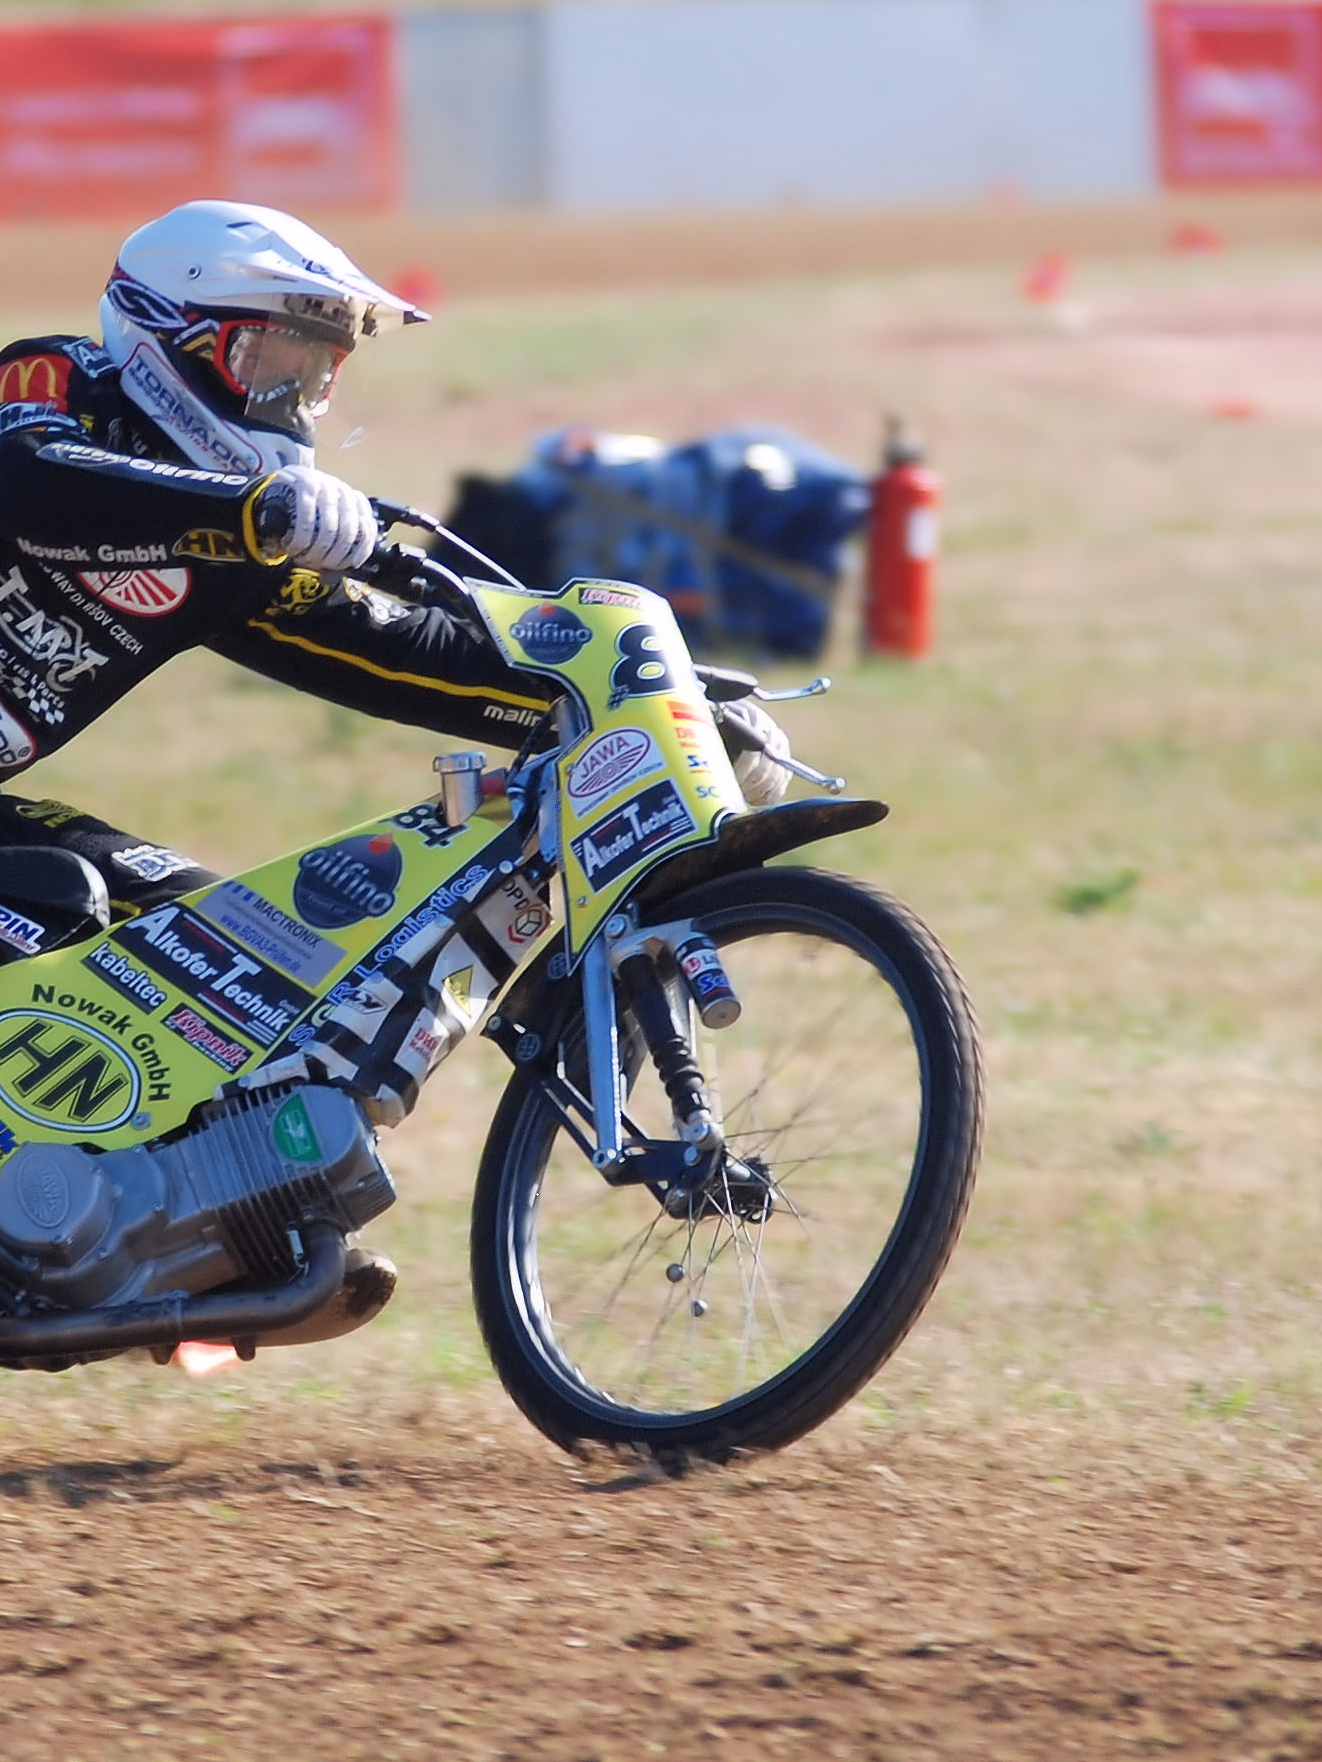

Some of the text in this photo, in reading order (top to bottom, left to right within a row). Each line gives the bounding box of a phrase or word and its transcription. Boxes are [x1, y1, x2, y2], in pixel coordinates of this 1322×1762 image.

[97, 543, 167, 563] GmbH
[109, 624, 143, 655] CZECH
[510, 621, 592, 643] oilfino
[582, 735, 631, 779] JAWA
[301, 848, 395, 916] oilfino
[253, 897, 324, 949] MACTRONIX
[89, 941, 168, 1008] kabeltec
[31, 984, 134, 1036] Nowak
[131, 1033, 172, 1102] GmbH
